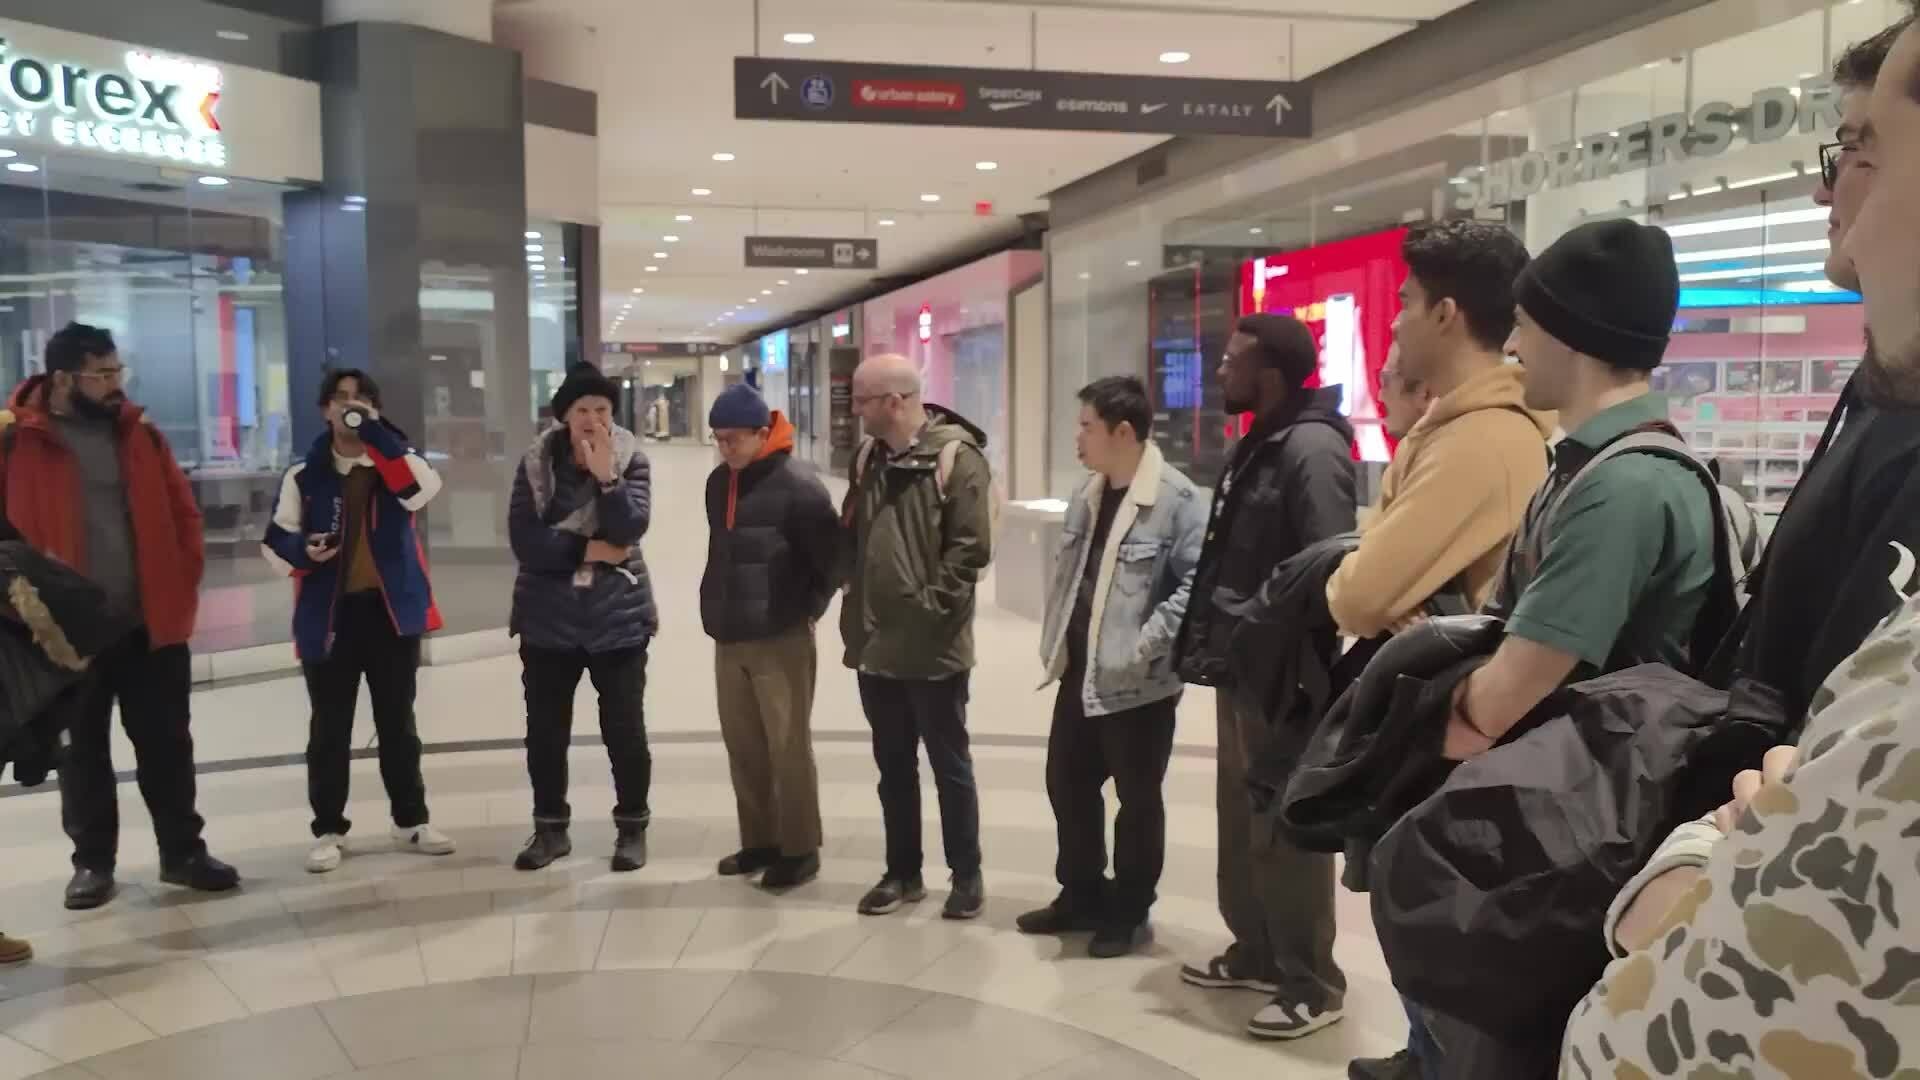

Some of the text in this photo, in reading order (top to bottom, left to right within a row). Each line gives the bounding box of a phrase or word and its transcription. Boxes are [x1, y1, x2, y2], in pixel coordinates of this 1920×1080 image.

[0, 37, 179, 124] orex
[1183, 103, 1252, 117] EATALY
[1455, 102, 1734, 210] SHOPPERS
